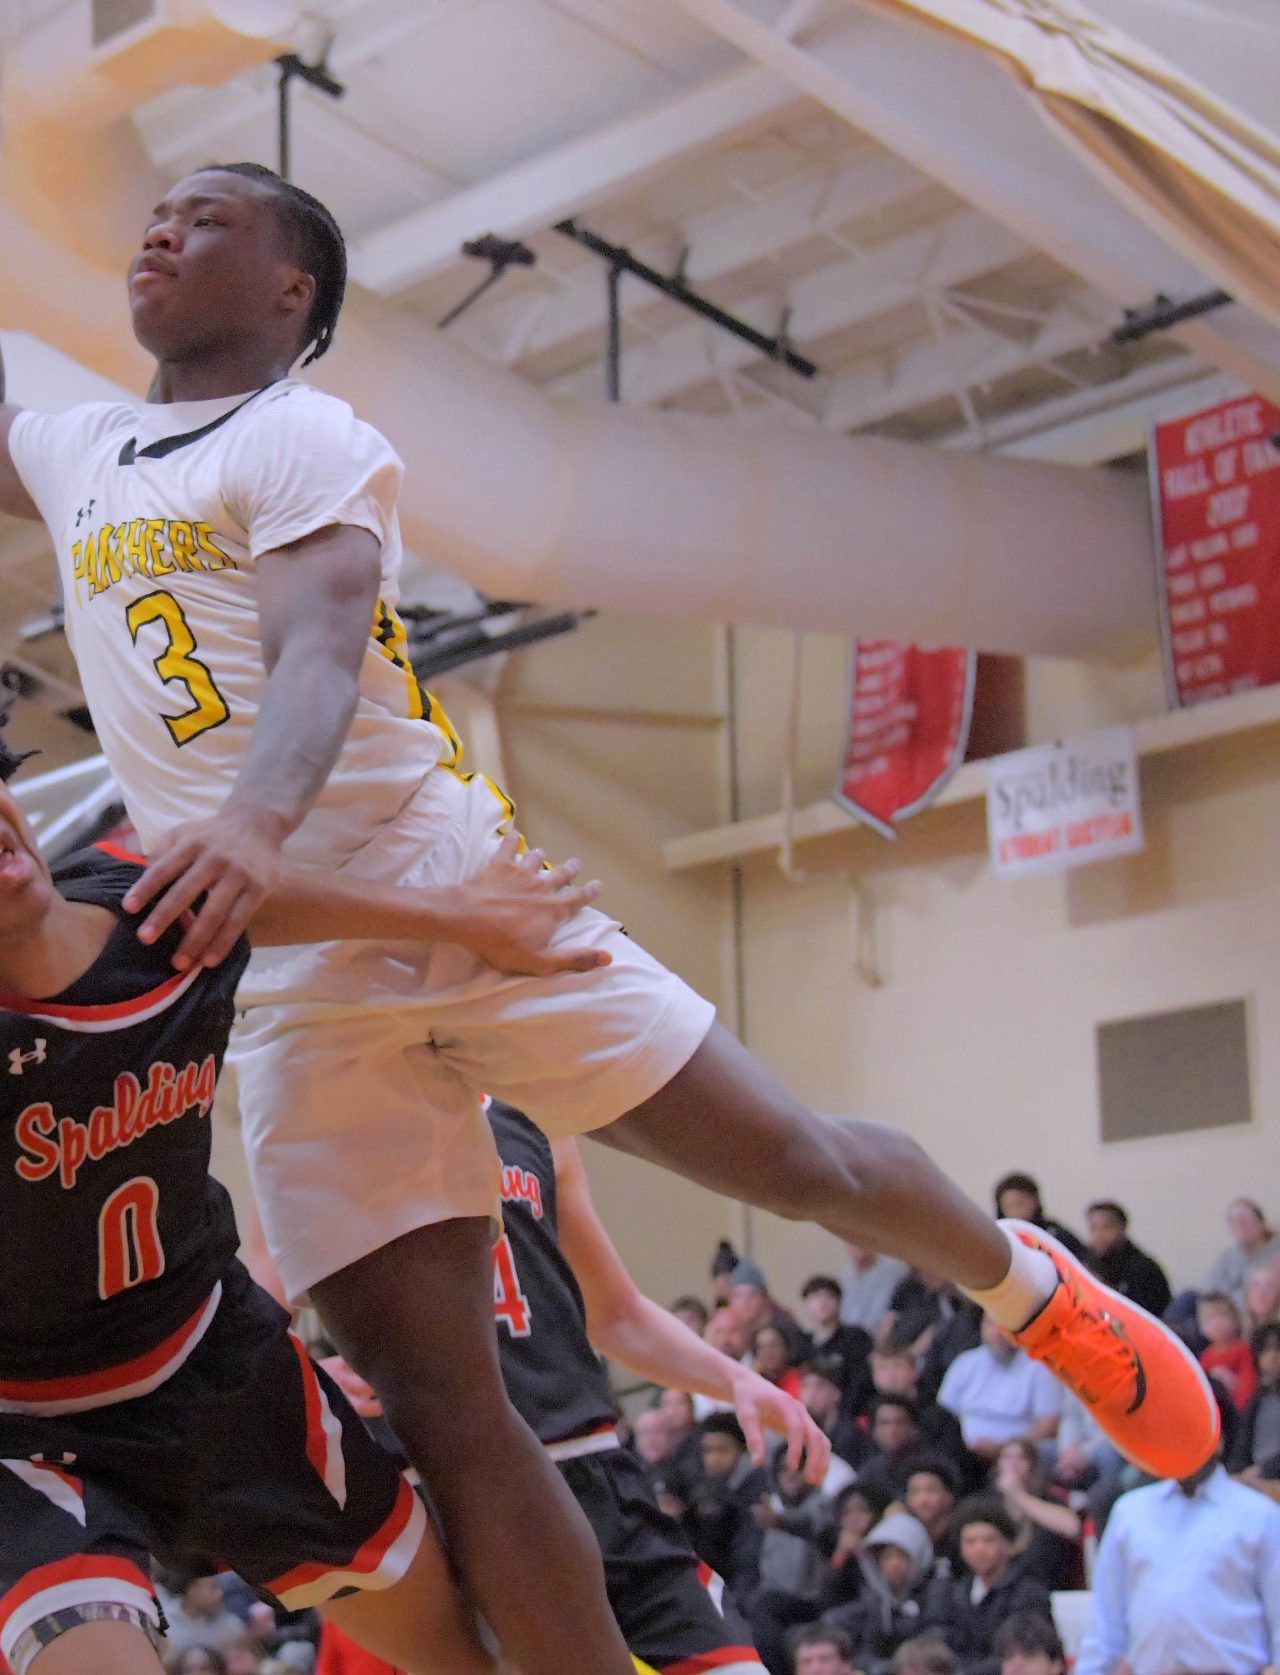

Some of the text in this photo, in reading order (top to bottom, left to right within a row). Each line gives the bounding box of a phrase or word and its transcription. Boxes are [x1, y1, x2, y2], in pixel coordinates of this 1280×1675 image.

[72, 517, 238, 610] PANTHERS
[125, 589, 231, 748] 3
[996, 753, 1127, 828] Spalding
[15, 1053, 215, 1189] Spalding
[98, 1176, 165, 1300] 0
